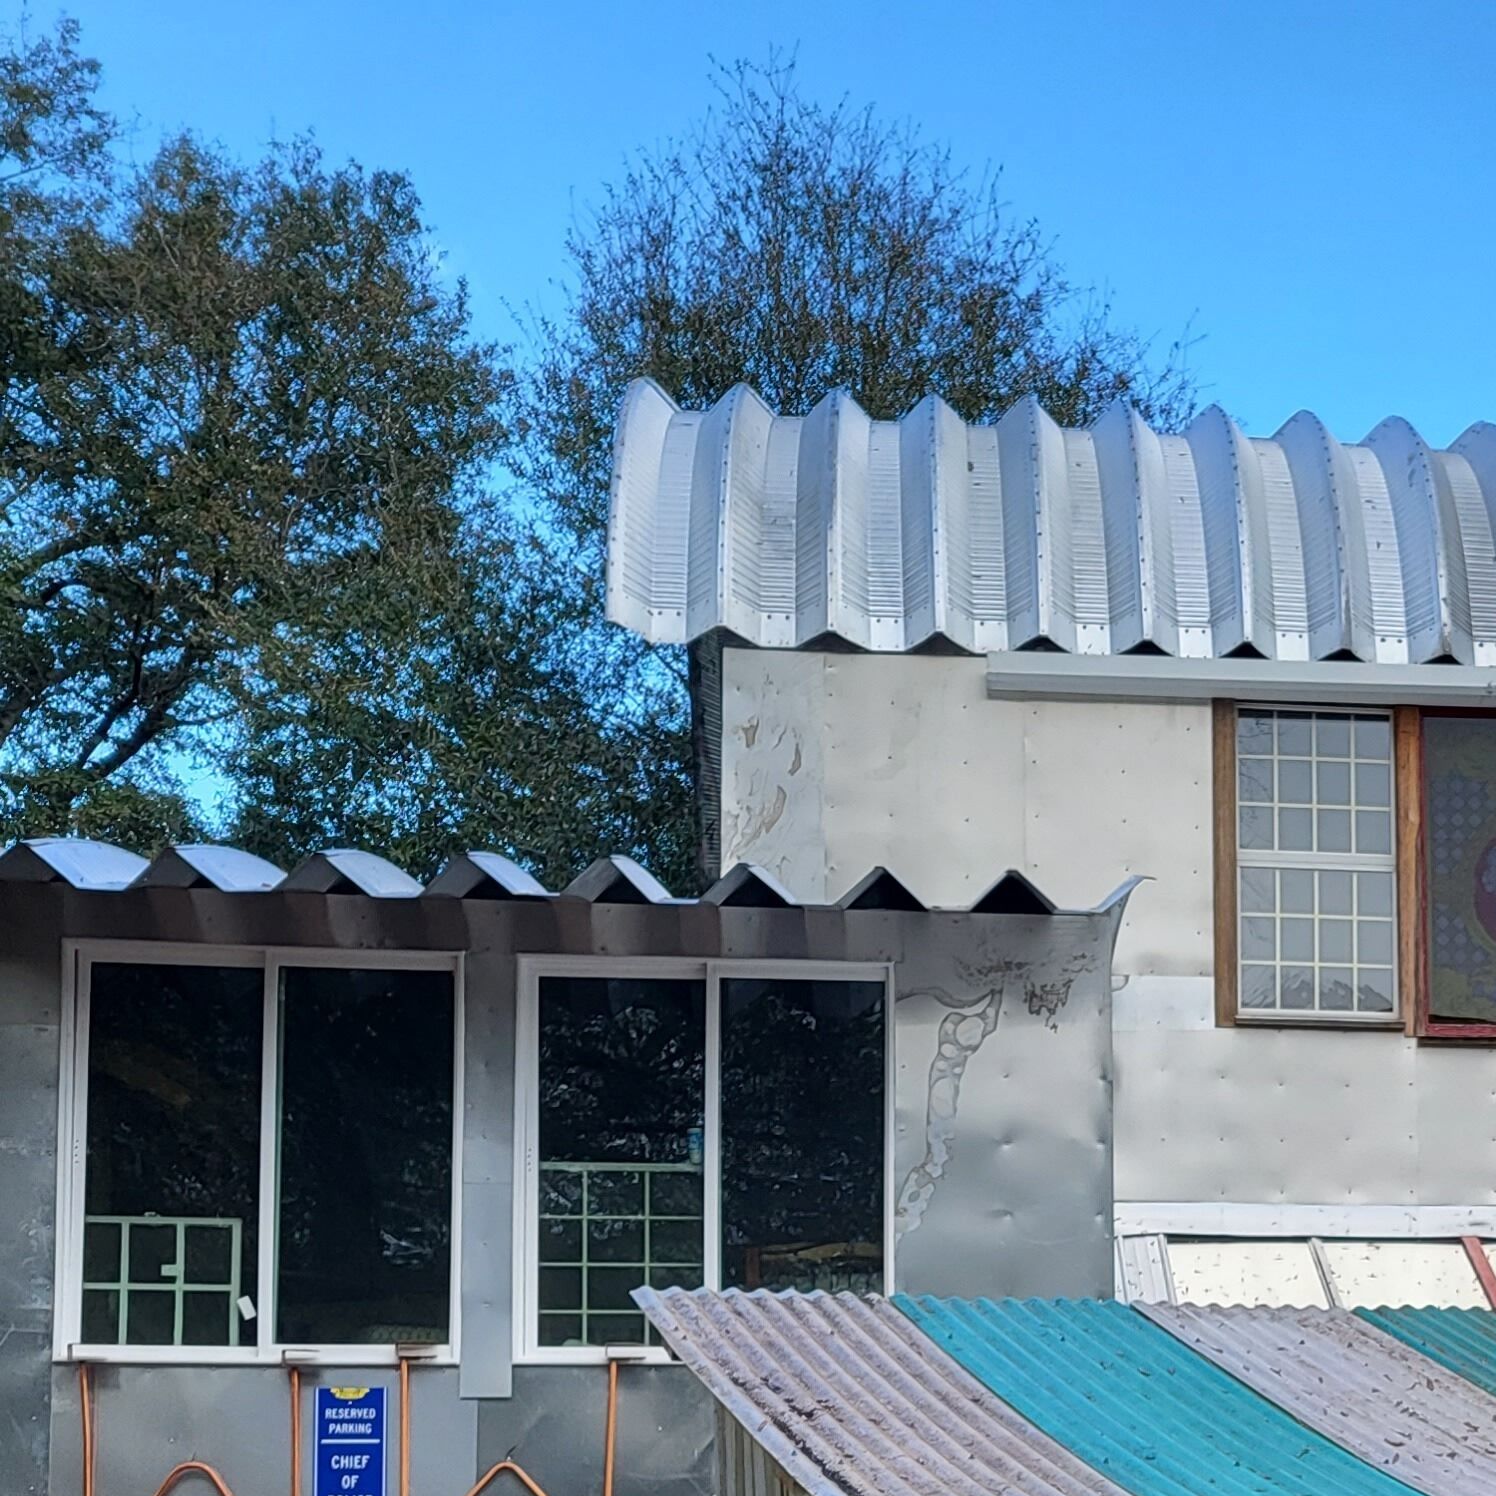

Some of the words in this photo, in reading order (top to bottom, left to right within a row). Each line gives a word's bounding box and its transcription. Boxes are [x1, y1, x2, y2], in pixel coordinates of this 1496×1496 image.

[325, 1408, 376, 1420] RESERVED
[328, 1423, 372, 1435] PARKING
[331, 1455, 370, 1470] CHIEF
[341, 1475, 359, 1489] OF
